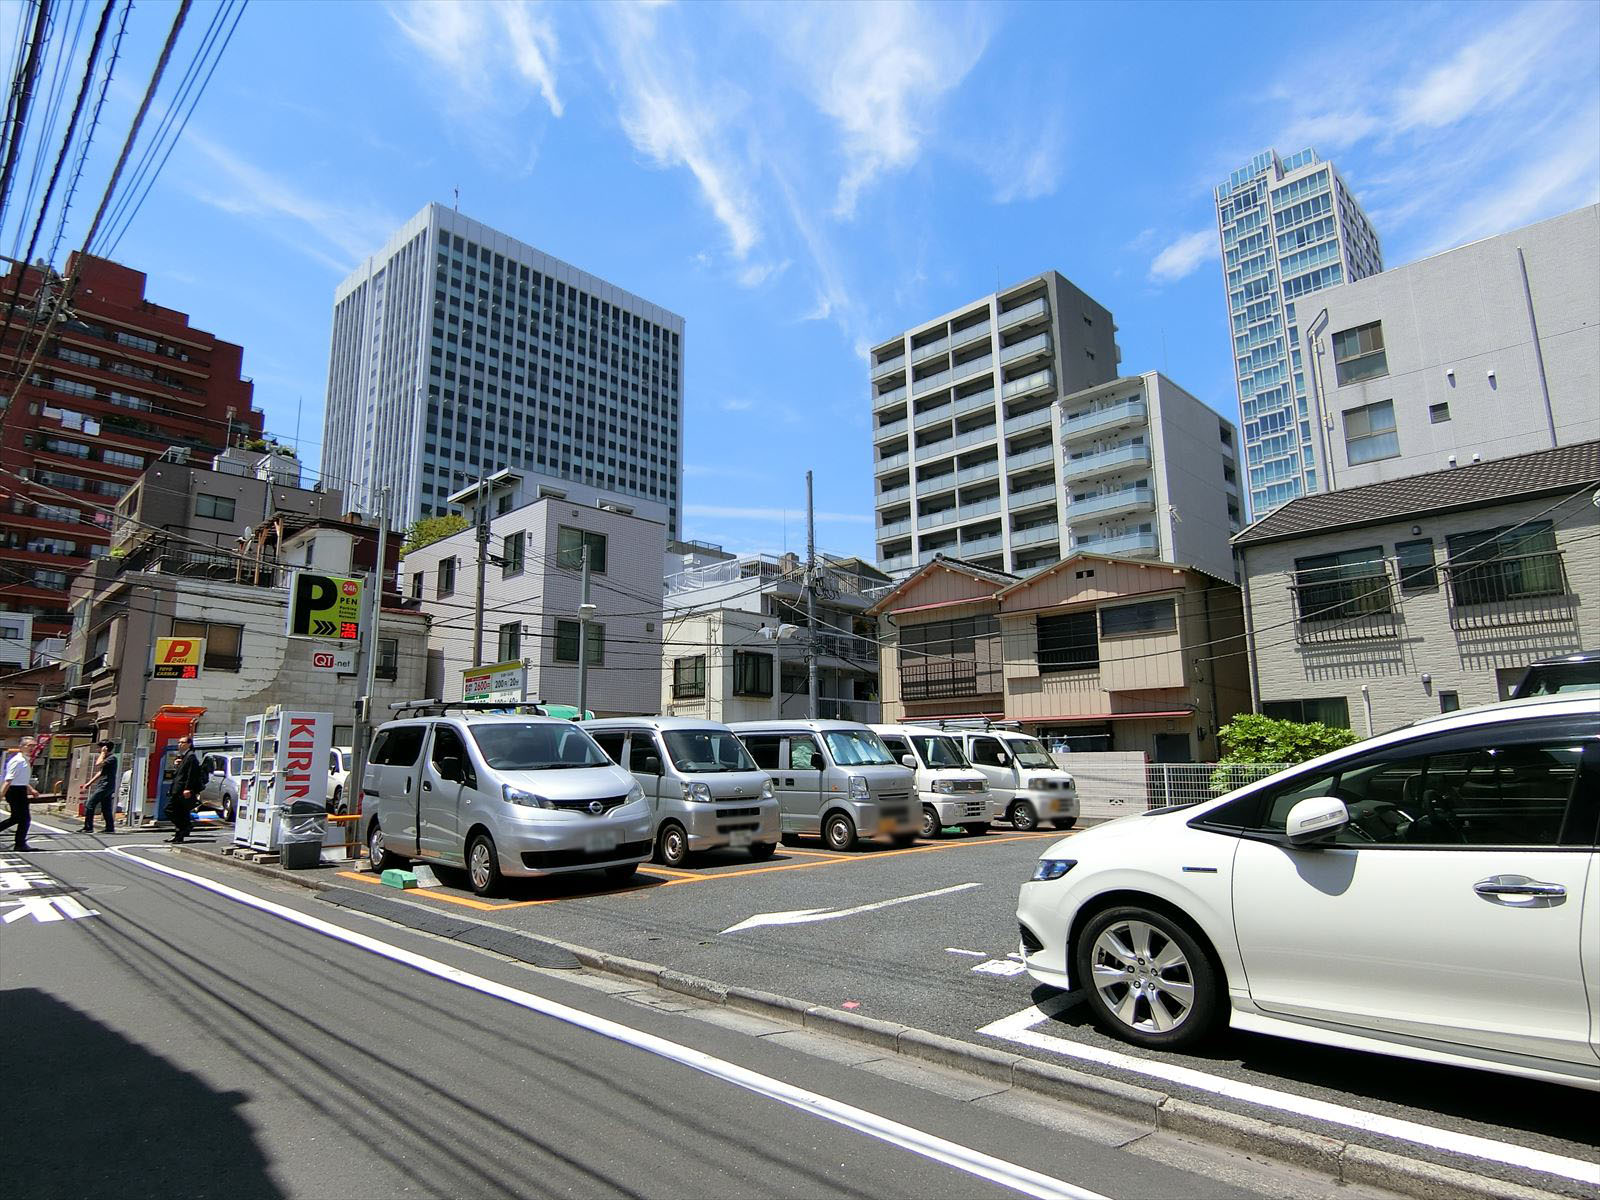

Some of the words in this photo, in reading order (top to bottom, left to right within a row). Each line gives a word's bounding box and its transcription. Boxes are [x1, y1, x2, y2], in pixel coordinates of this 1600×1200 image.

[343, 583, 357, 592] 24h
[294, 574, 338, 634] P
[340, 597, 358, 605] PEN
[163, 640, 193, 663] P
[15, 709, 30, 719] P
[284, 718, 316, 801] KIRIN
